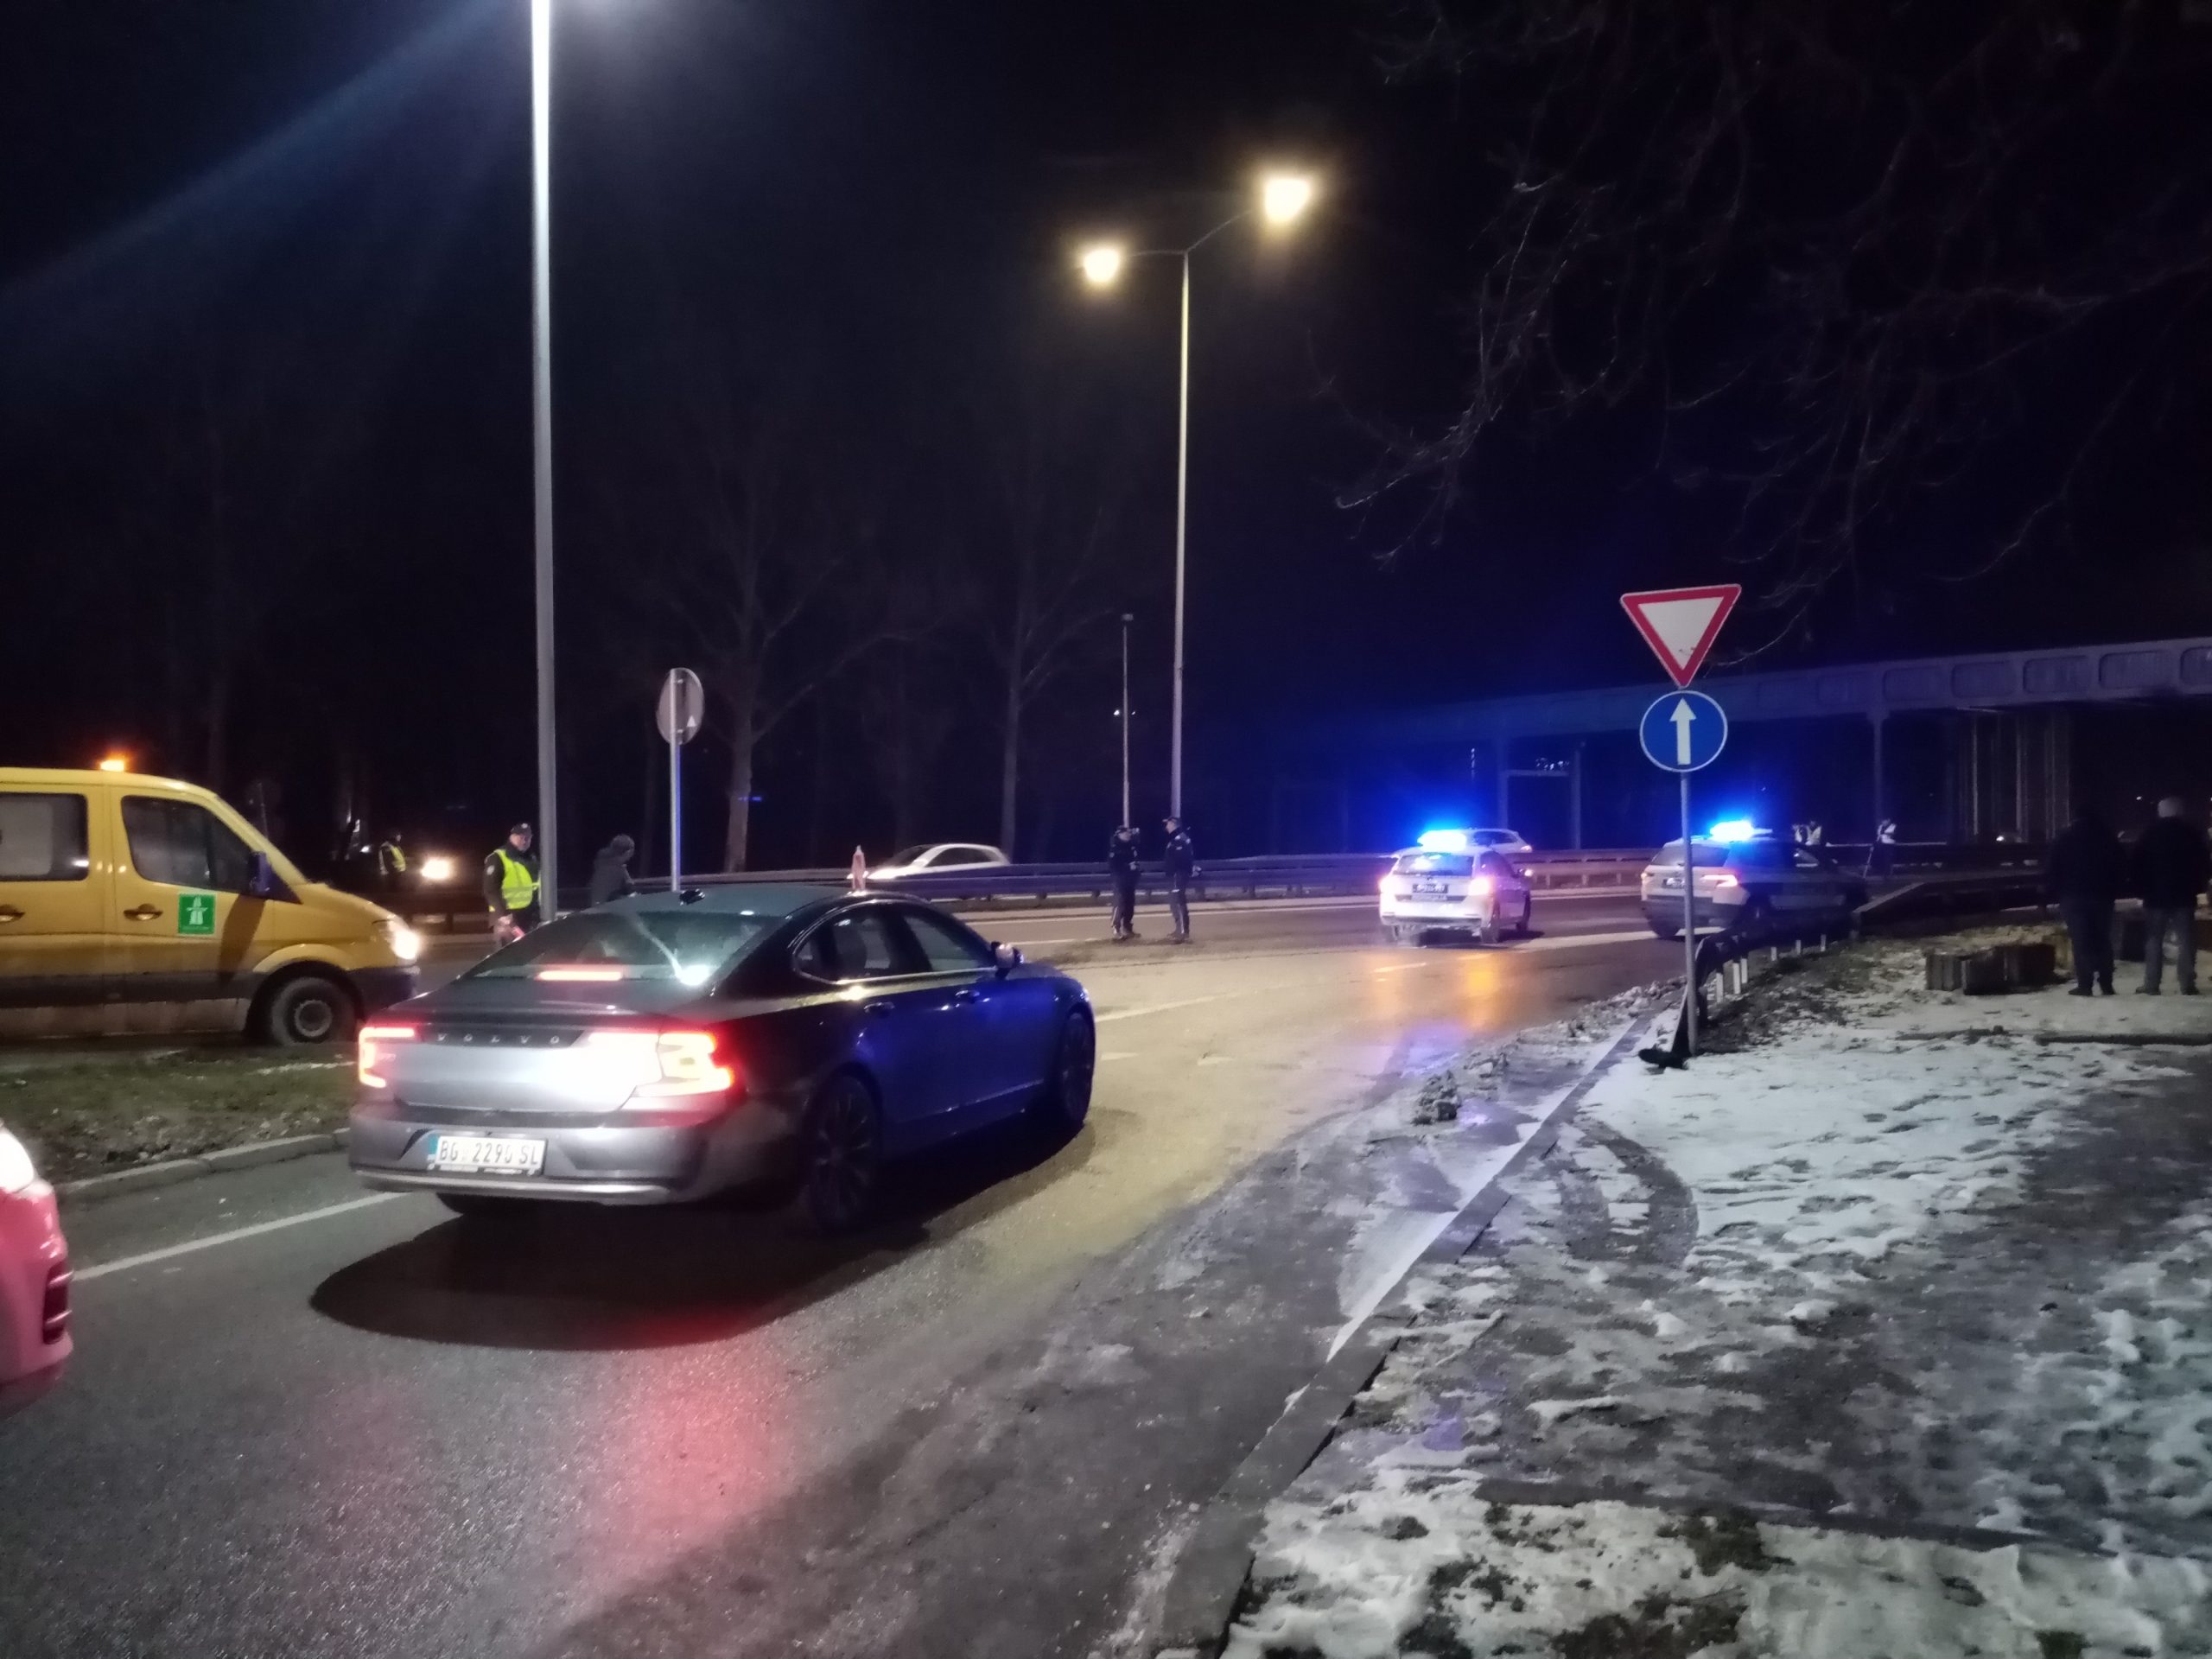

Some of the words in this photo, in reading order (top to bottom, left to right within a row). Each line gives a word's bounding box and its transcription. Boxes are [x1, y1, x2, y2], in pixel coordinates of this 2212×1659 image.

[436, 1033, 561, 1045] VOLVO
[440, 1140, 460, 1161] BG
[518, 1145, 539, 1166] SL
